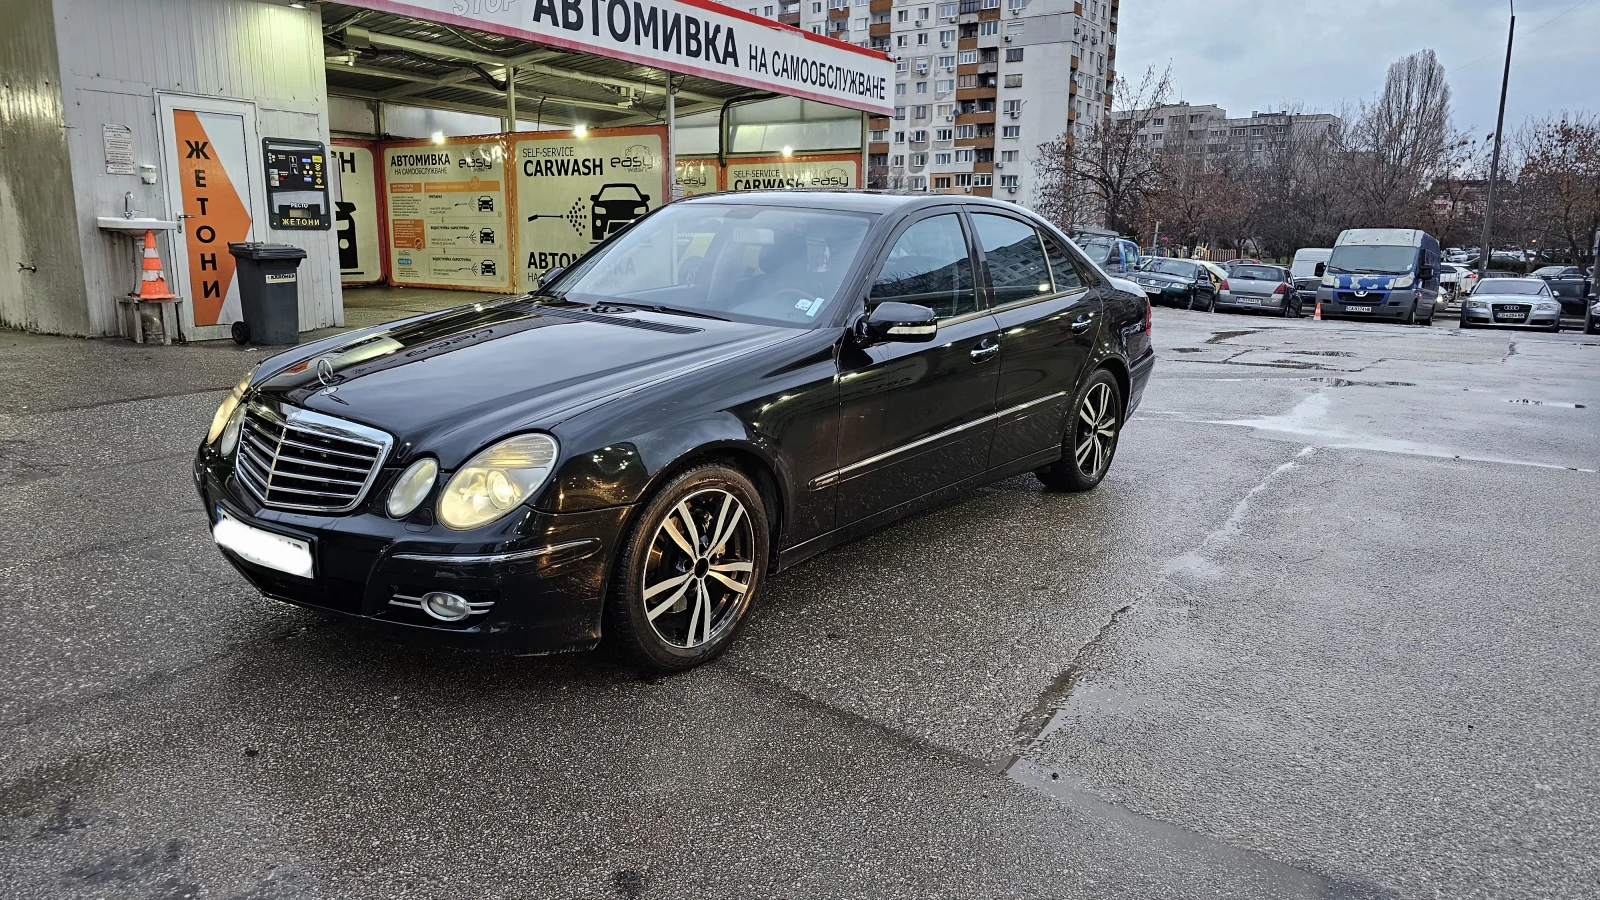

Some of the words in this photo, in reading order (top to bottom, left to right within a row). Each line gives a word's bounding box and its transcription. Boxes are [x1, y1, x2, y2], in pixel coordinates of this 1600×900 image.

[532, 0, 739, 68] АВТОМИВКА
[749, 44, 768, 75] НА
[772, 50, 886, 101] САМООБСЛУЖВАНЕ
[522, 146, 574, 158] SELF-SERVICE
[390, 153, 451, 167] АВТОМИВКА
[458, 157, 493, 170] easy
[394, 168, 402, 176] НА
[401, 166, 448, 176] САМООБСЛУЖВАНЕ
[523, 157, 604, 177] CARWASH
[733, 169, 780, 179] SELF-SERVICE
[734, 178, 805, 190] CARWASH
[811, 176, 849, 188] easy
[184, 139, 221, 299] ЖЕТОНИ
[281, 218, 320, 227] ЖЕТОНИ
